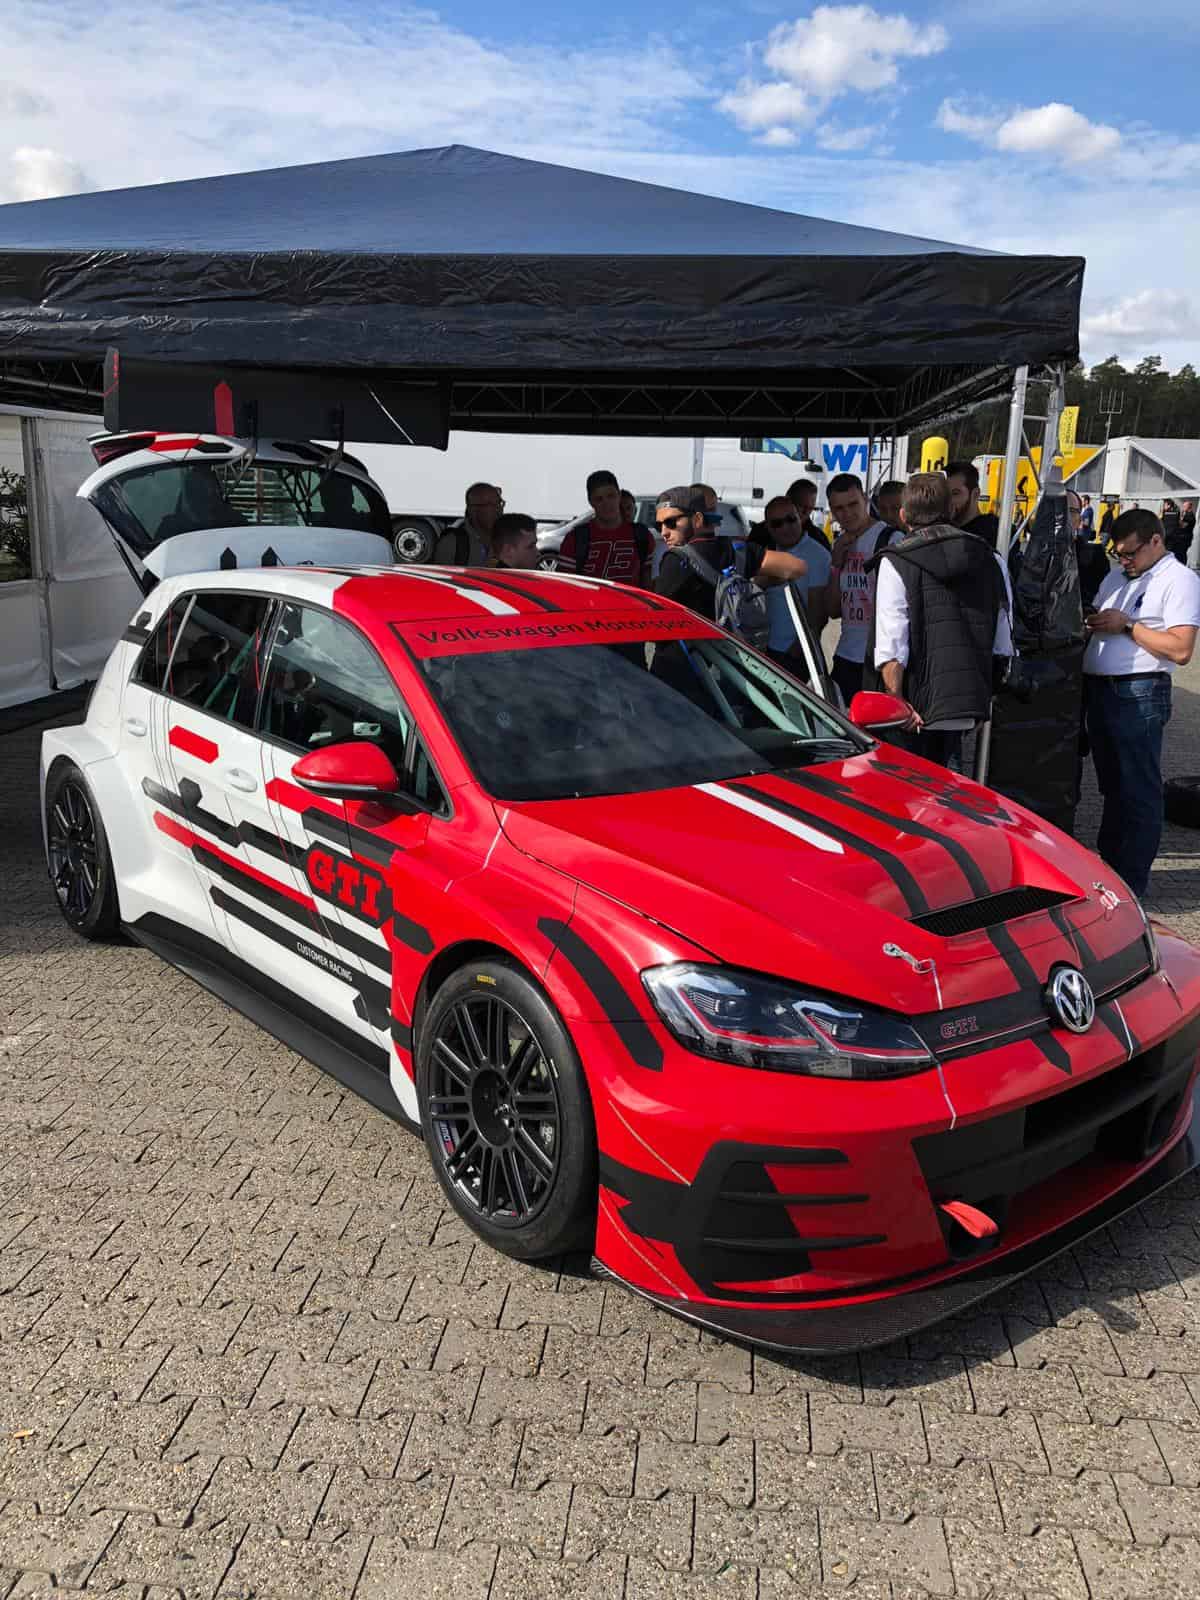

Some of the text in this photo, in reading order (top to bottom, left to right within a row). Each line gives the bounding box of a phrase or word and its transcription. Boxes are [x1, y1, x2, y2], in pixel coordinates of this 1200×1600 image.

[418, 622, 582, 644] Volkswagen
[306, 849, 382, 921] GTI
[296, 941, 353, 982] CUSTOMER RACING
[940, 1015, 979, 1039] GTI
